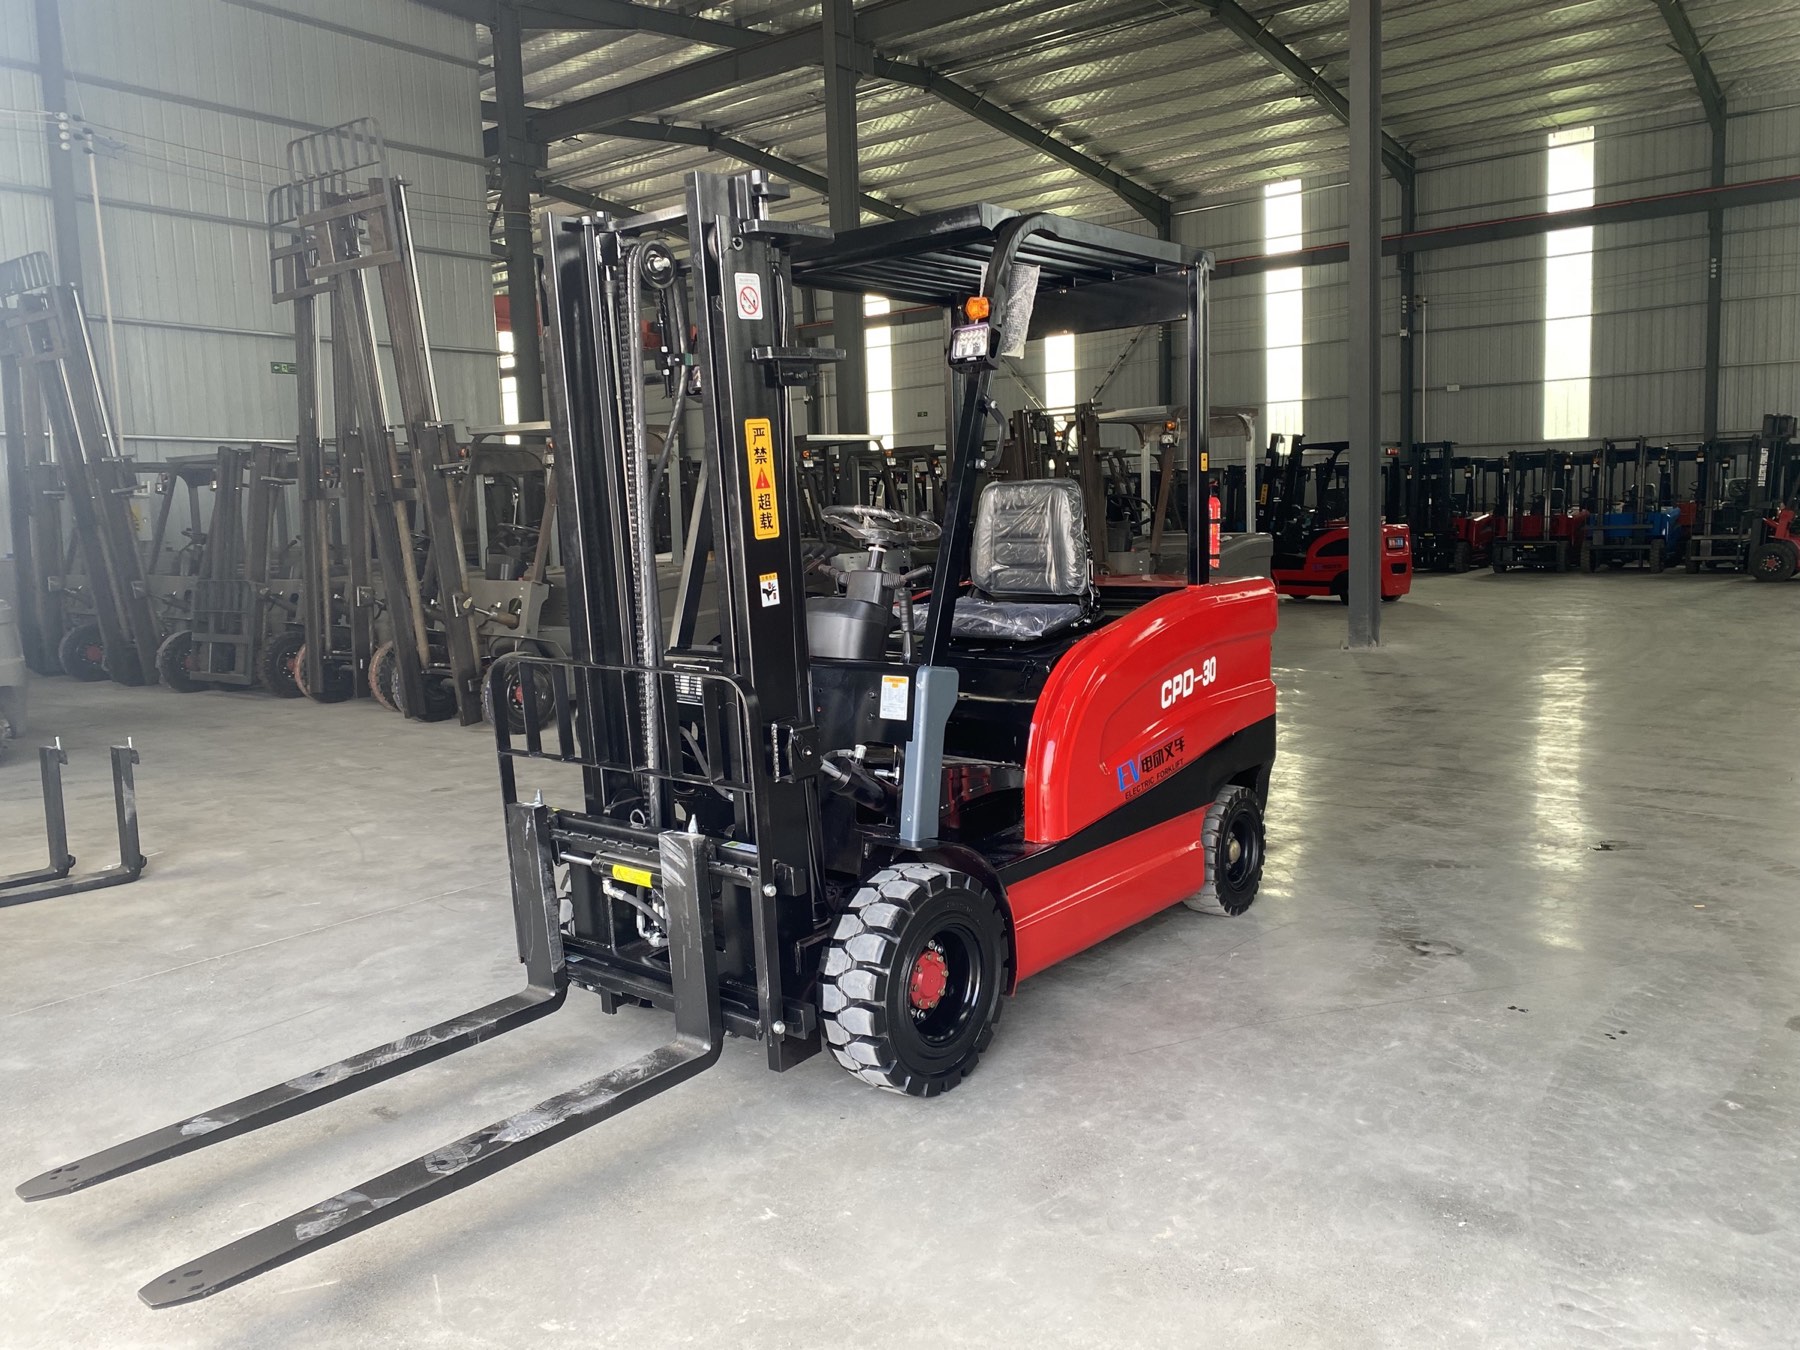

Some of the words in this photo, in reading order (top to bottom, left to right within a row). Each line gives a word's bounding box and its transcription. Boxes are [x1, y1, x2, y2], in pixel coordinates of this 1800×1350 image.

[752, 427, 774, 530] 严禁超载
[1161, 656, 1216, 709] CPD-30
[1116, 752, 1143, 792] EV
[1124, 777, 1155, 800] ELECTRIC
[1156, 759, 1184, 780] FORKLIFT
